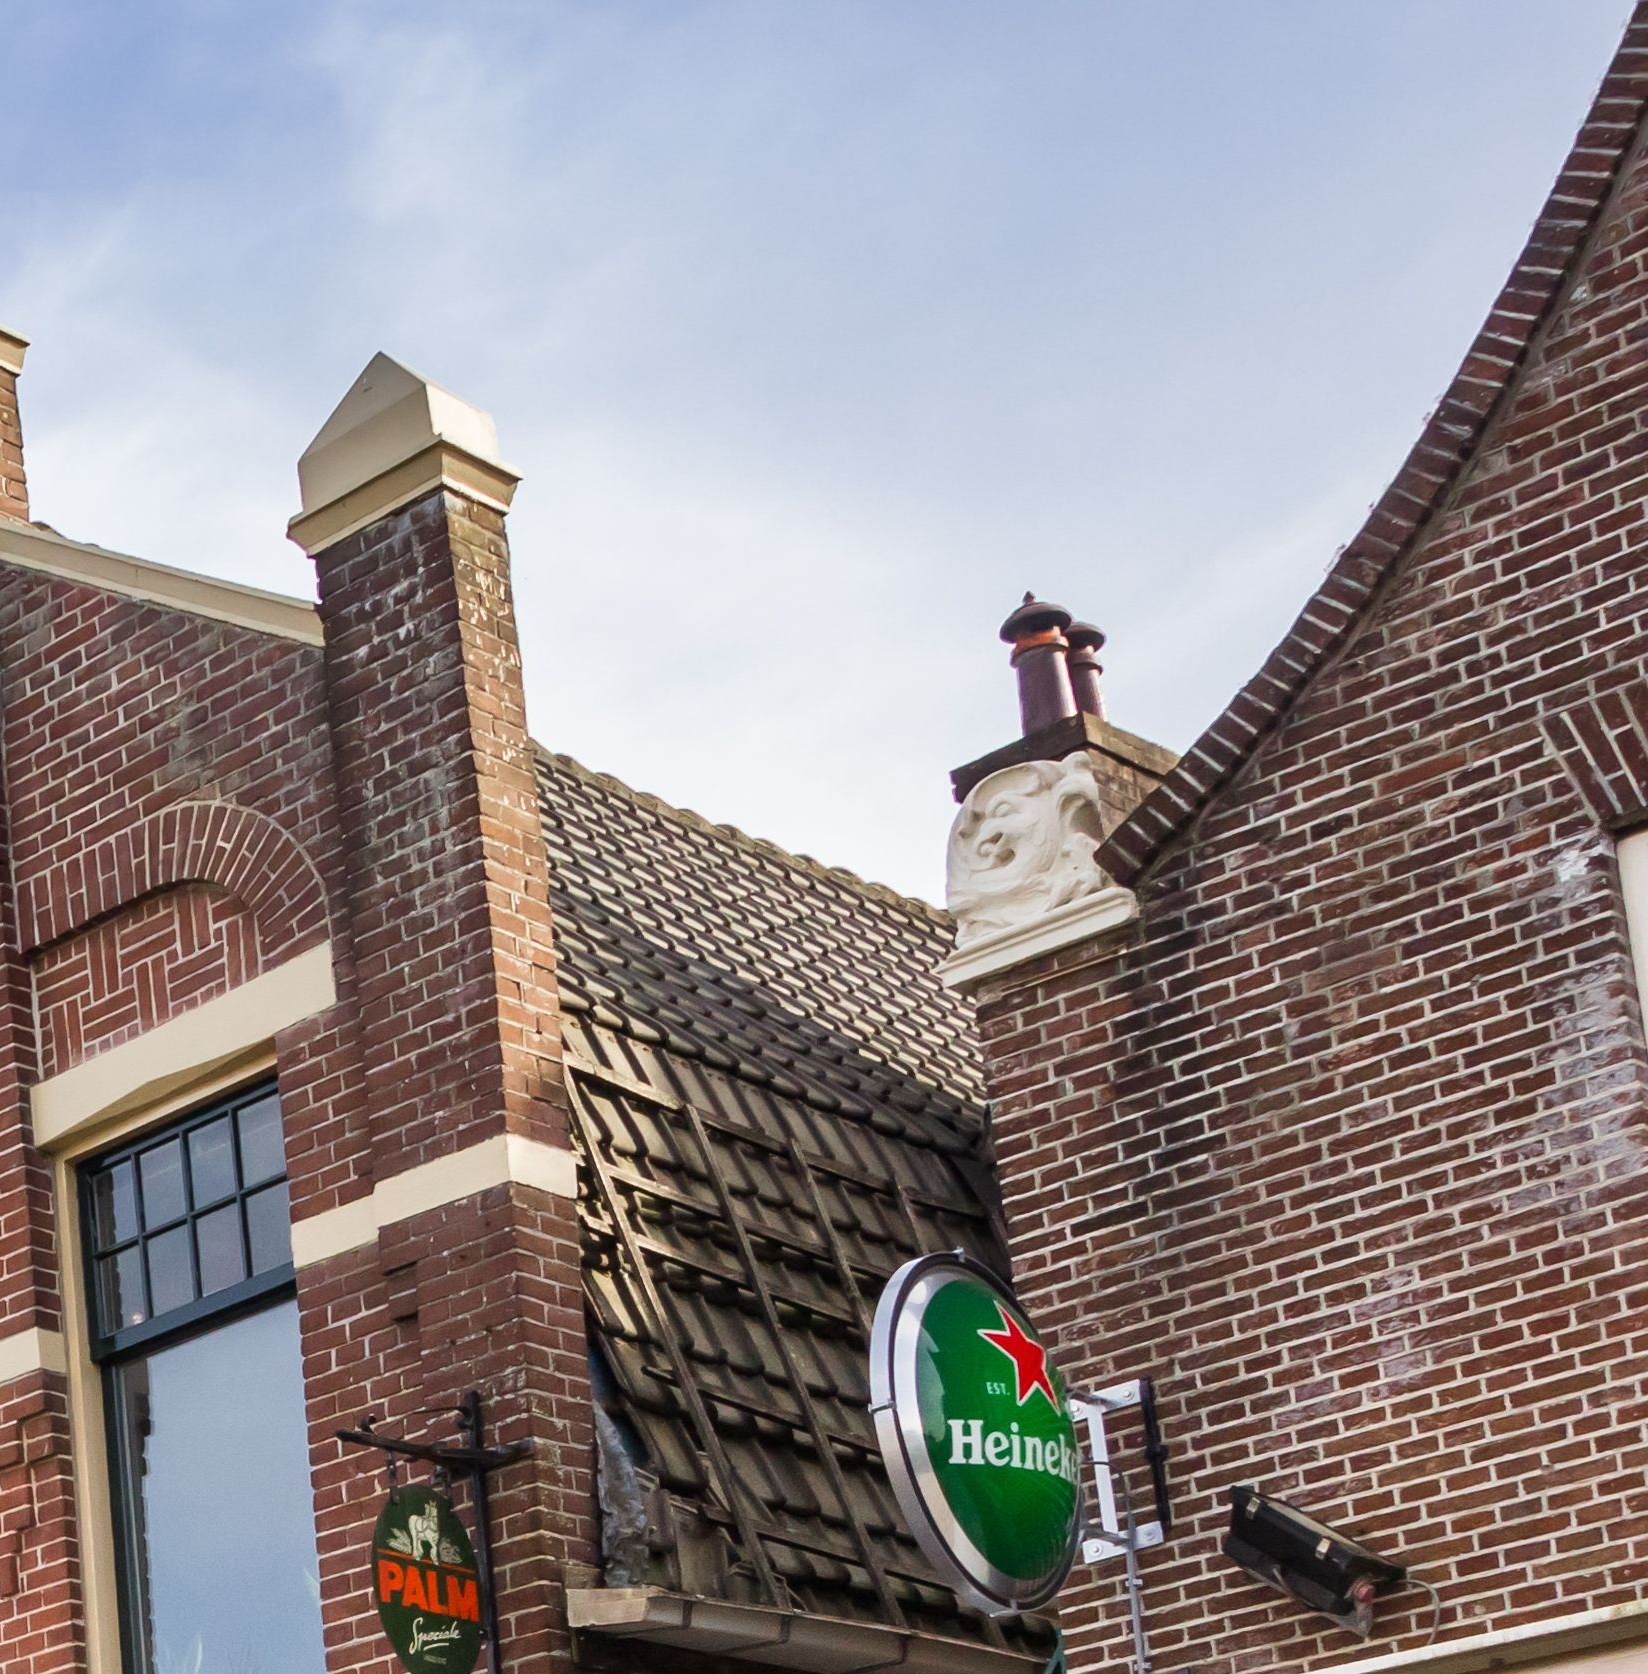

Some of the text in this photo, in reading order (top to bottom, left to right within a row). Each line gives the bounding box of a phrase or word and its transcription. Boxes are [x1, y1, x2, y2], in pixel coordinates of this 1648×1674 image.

[986, 1382, 1010, 1395] EST.
[378, 1559, 480, 1622] PALM
[409, 1617, 461, 1654] Speciale
